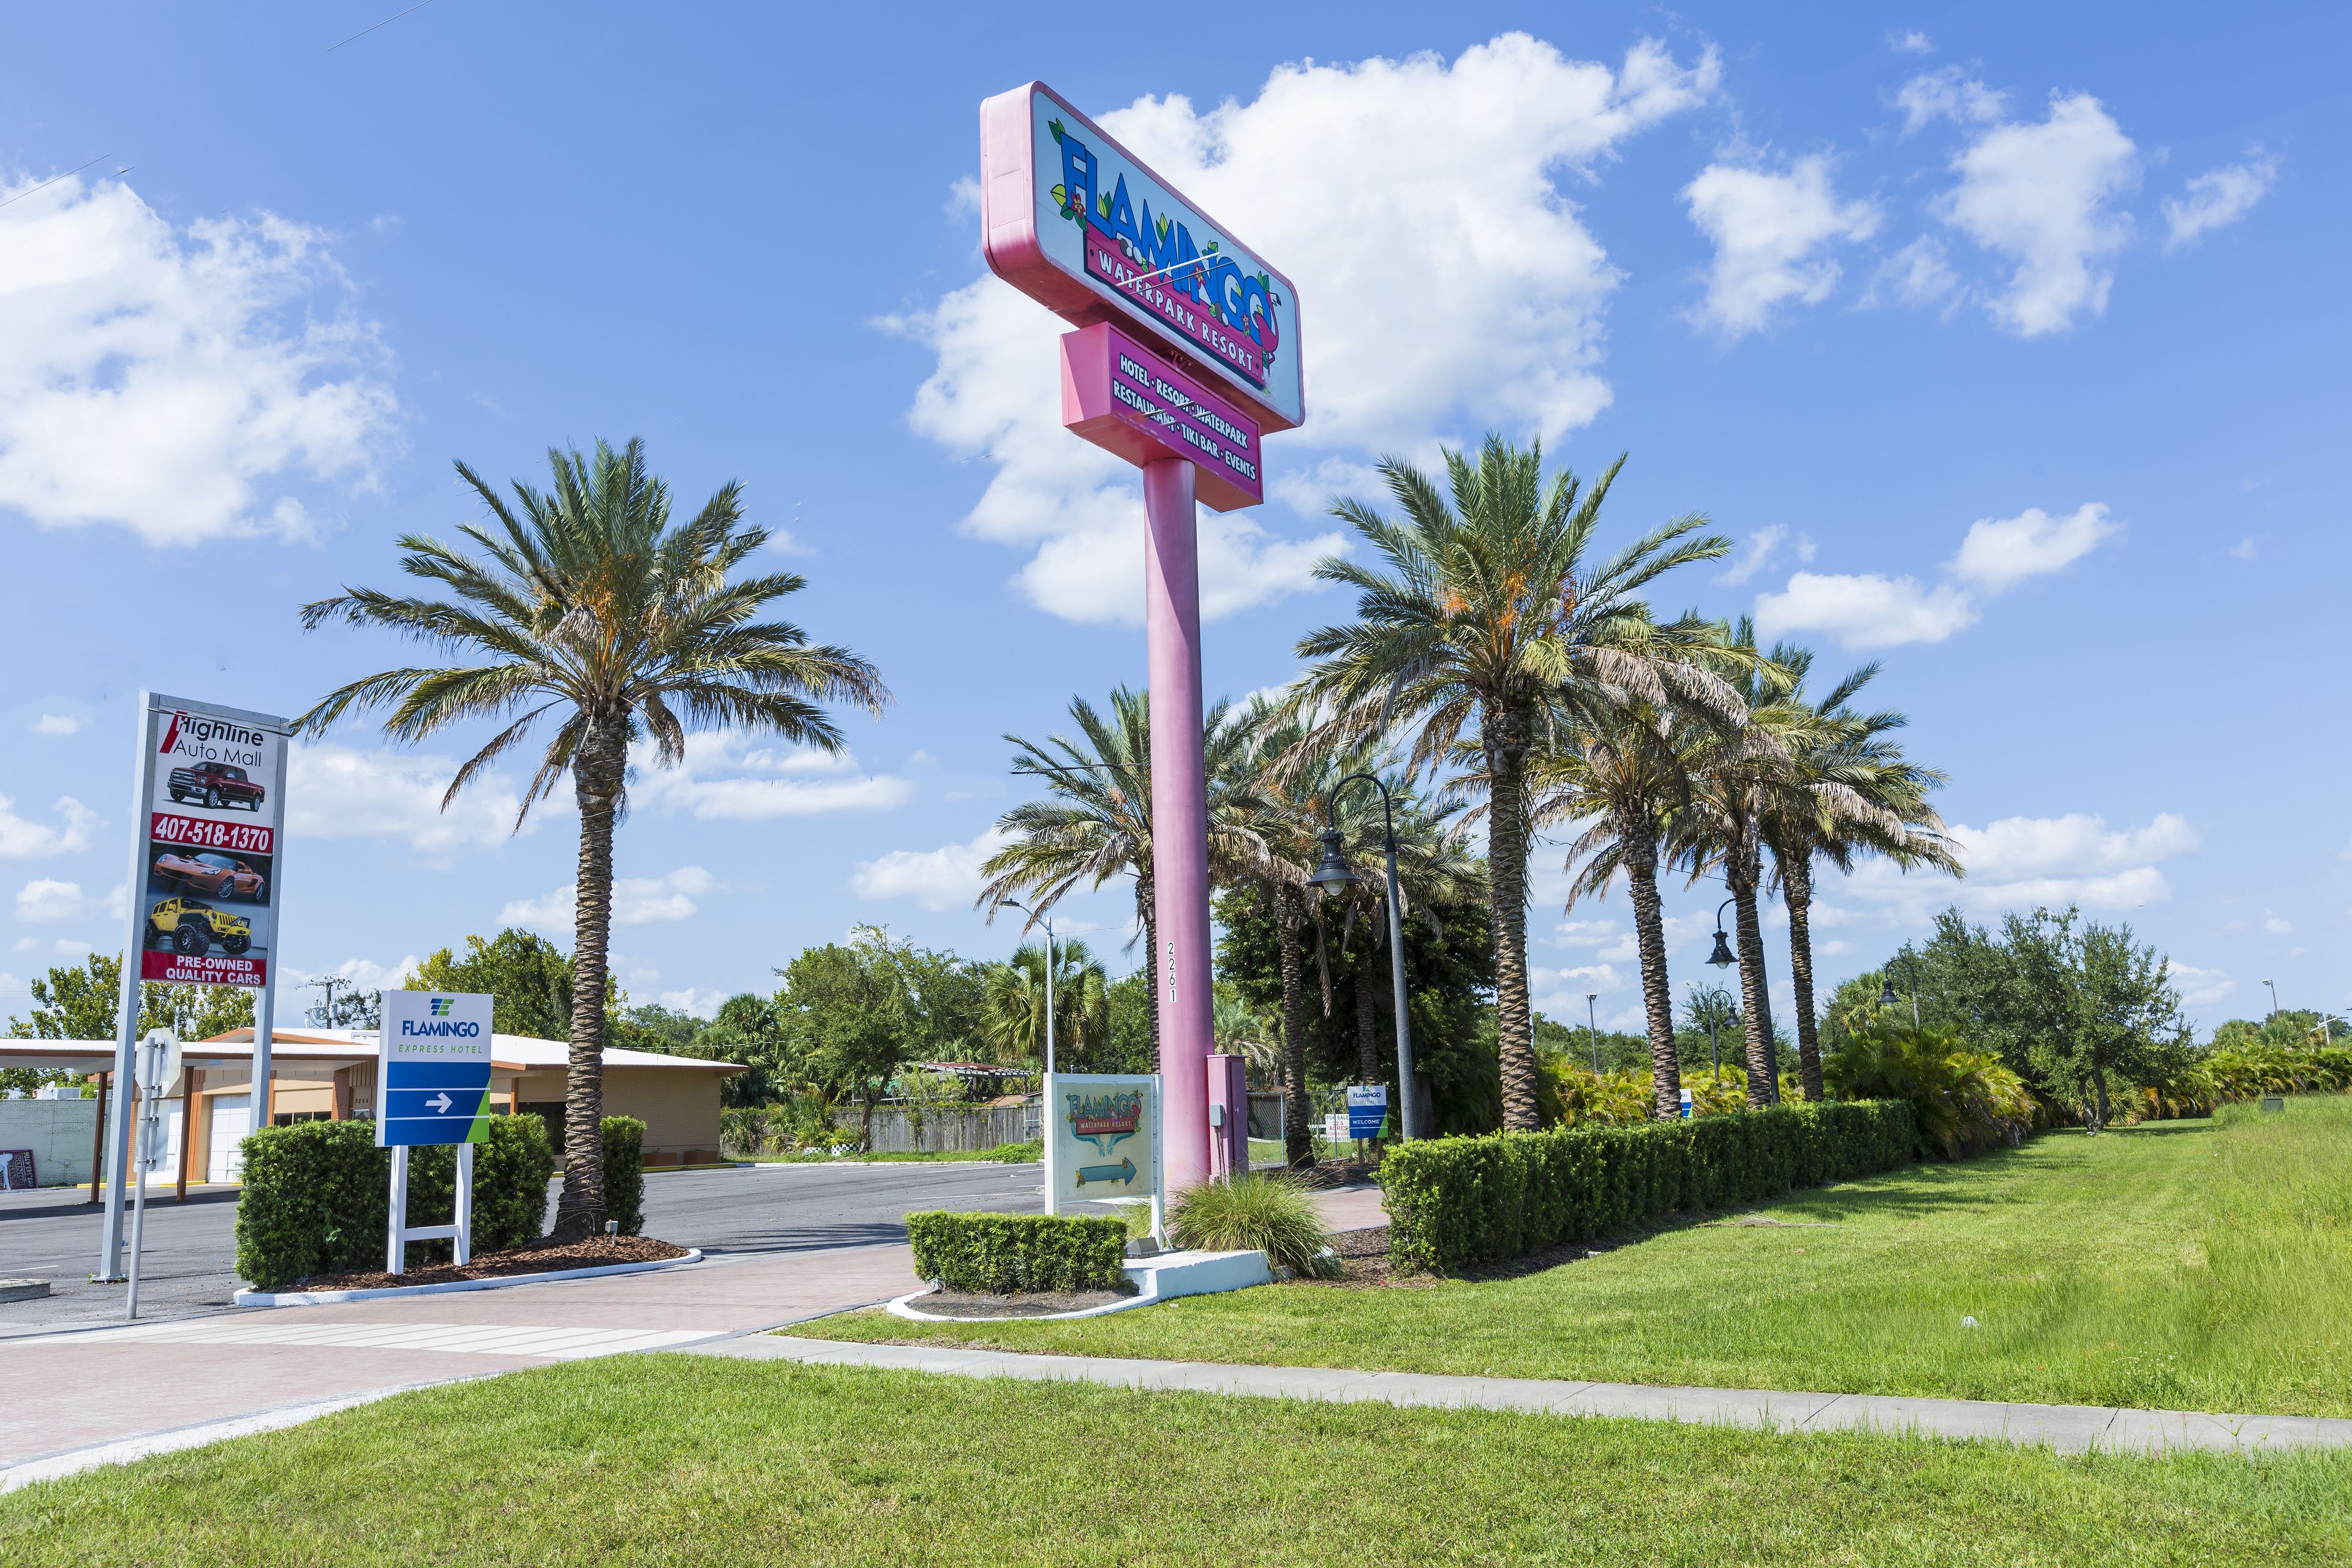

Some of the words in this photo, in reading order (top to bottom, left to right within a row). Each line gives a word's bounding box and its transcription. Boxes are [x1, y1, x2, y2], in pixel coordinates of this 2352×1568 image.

[1060, 131, 1274, 346] FLAMINGO
[1098, 249, 1196, 332] WATERPARK
[1201, 321, 1253, 371] RESORT
[1120, 352, 1150, 388] HOTEL
[1156, 376, 1190, 414] RESORT
[1196, 404, 1248, 449] WATERPARK
[1113, 378, 1175, 433] RESTAURANT
[1181, 422, 1199, 447] TIKI
[1200, 432, 1219, 459] BAR
[1224, 450, 1256, 481] EVENTS
[176, 717, 264, 747] Highline
[173, 739, 217, 760] Auto
[224, 747, 262, 767] Mall
[155, 816, 269, 851] 407-518-1370
[166, 968, 224, 982] QUALITY
[227, 972, 261, 984] CARS
[177, 955, 253, 971] PRE-OWNED
[402, 1020, 480, 1038] FLAMINGO
[398, 1044, 444, 1054] EXPRESS
[451, 1045, 482, 1054] HOTEL
[1069, 1095, 1138, 1119] FLAMINGO
